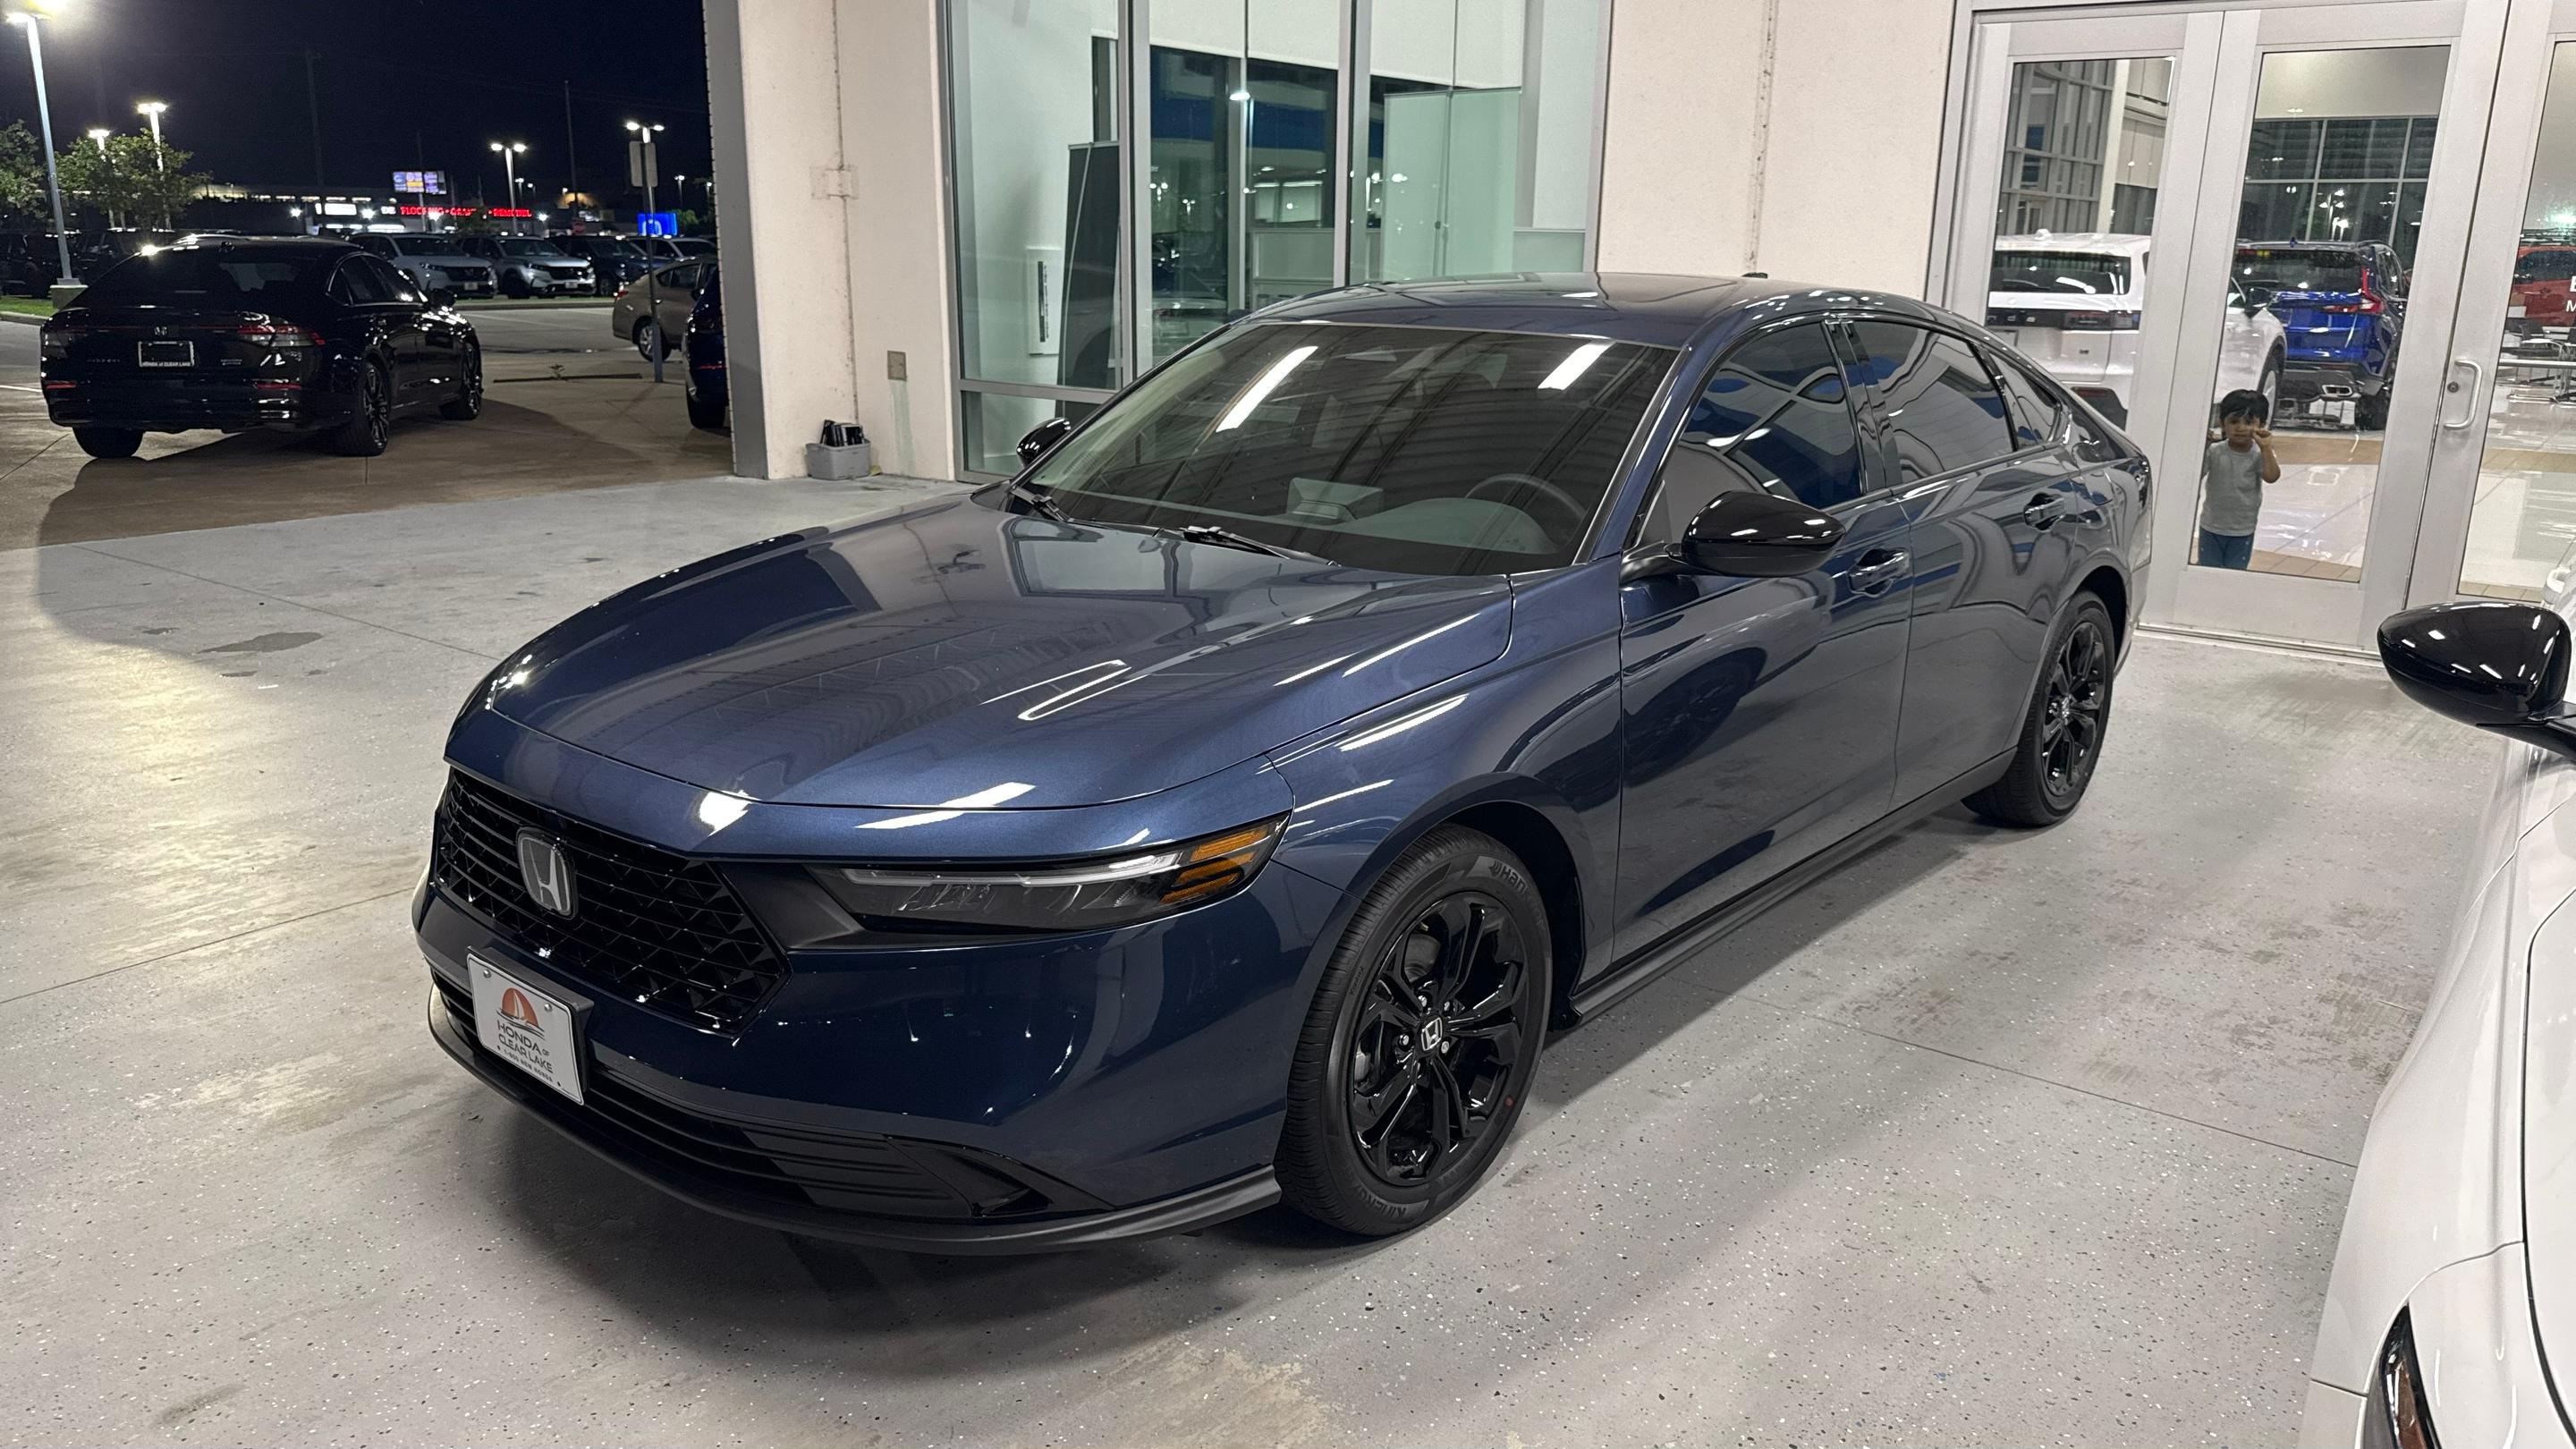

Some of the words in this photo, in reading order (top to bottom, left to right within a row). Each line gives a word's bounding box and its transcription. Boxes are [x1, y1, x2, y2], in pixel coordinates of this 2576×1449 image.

[497, 1020, 544, 1053] HONDA
[498, 1033, 530, 1061] CLEAR
[529, 1050, 554, 1073] LAKE
